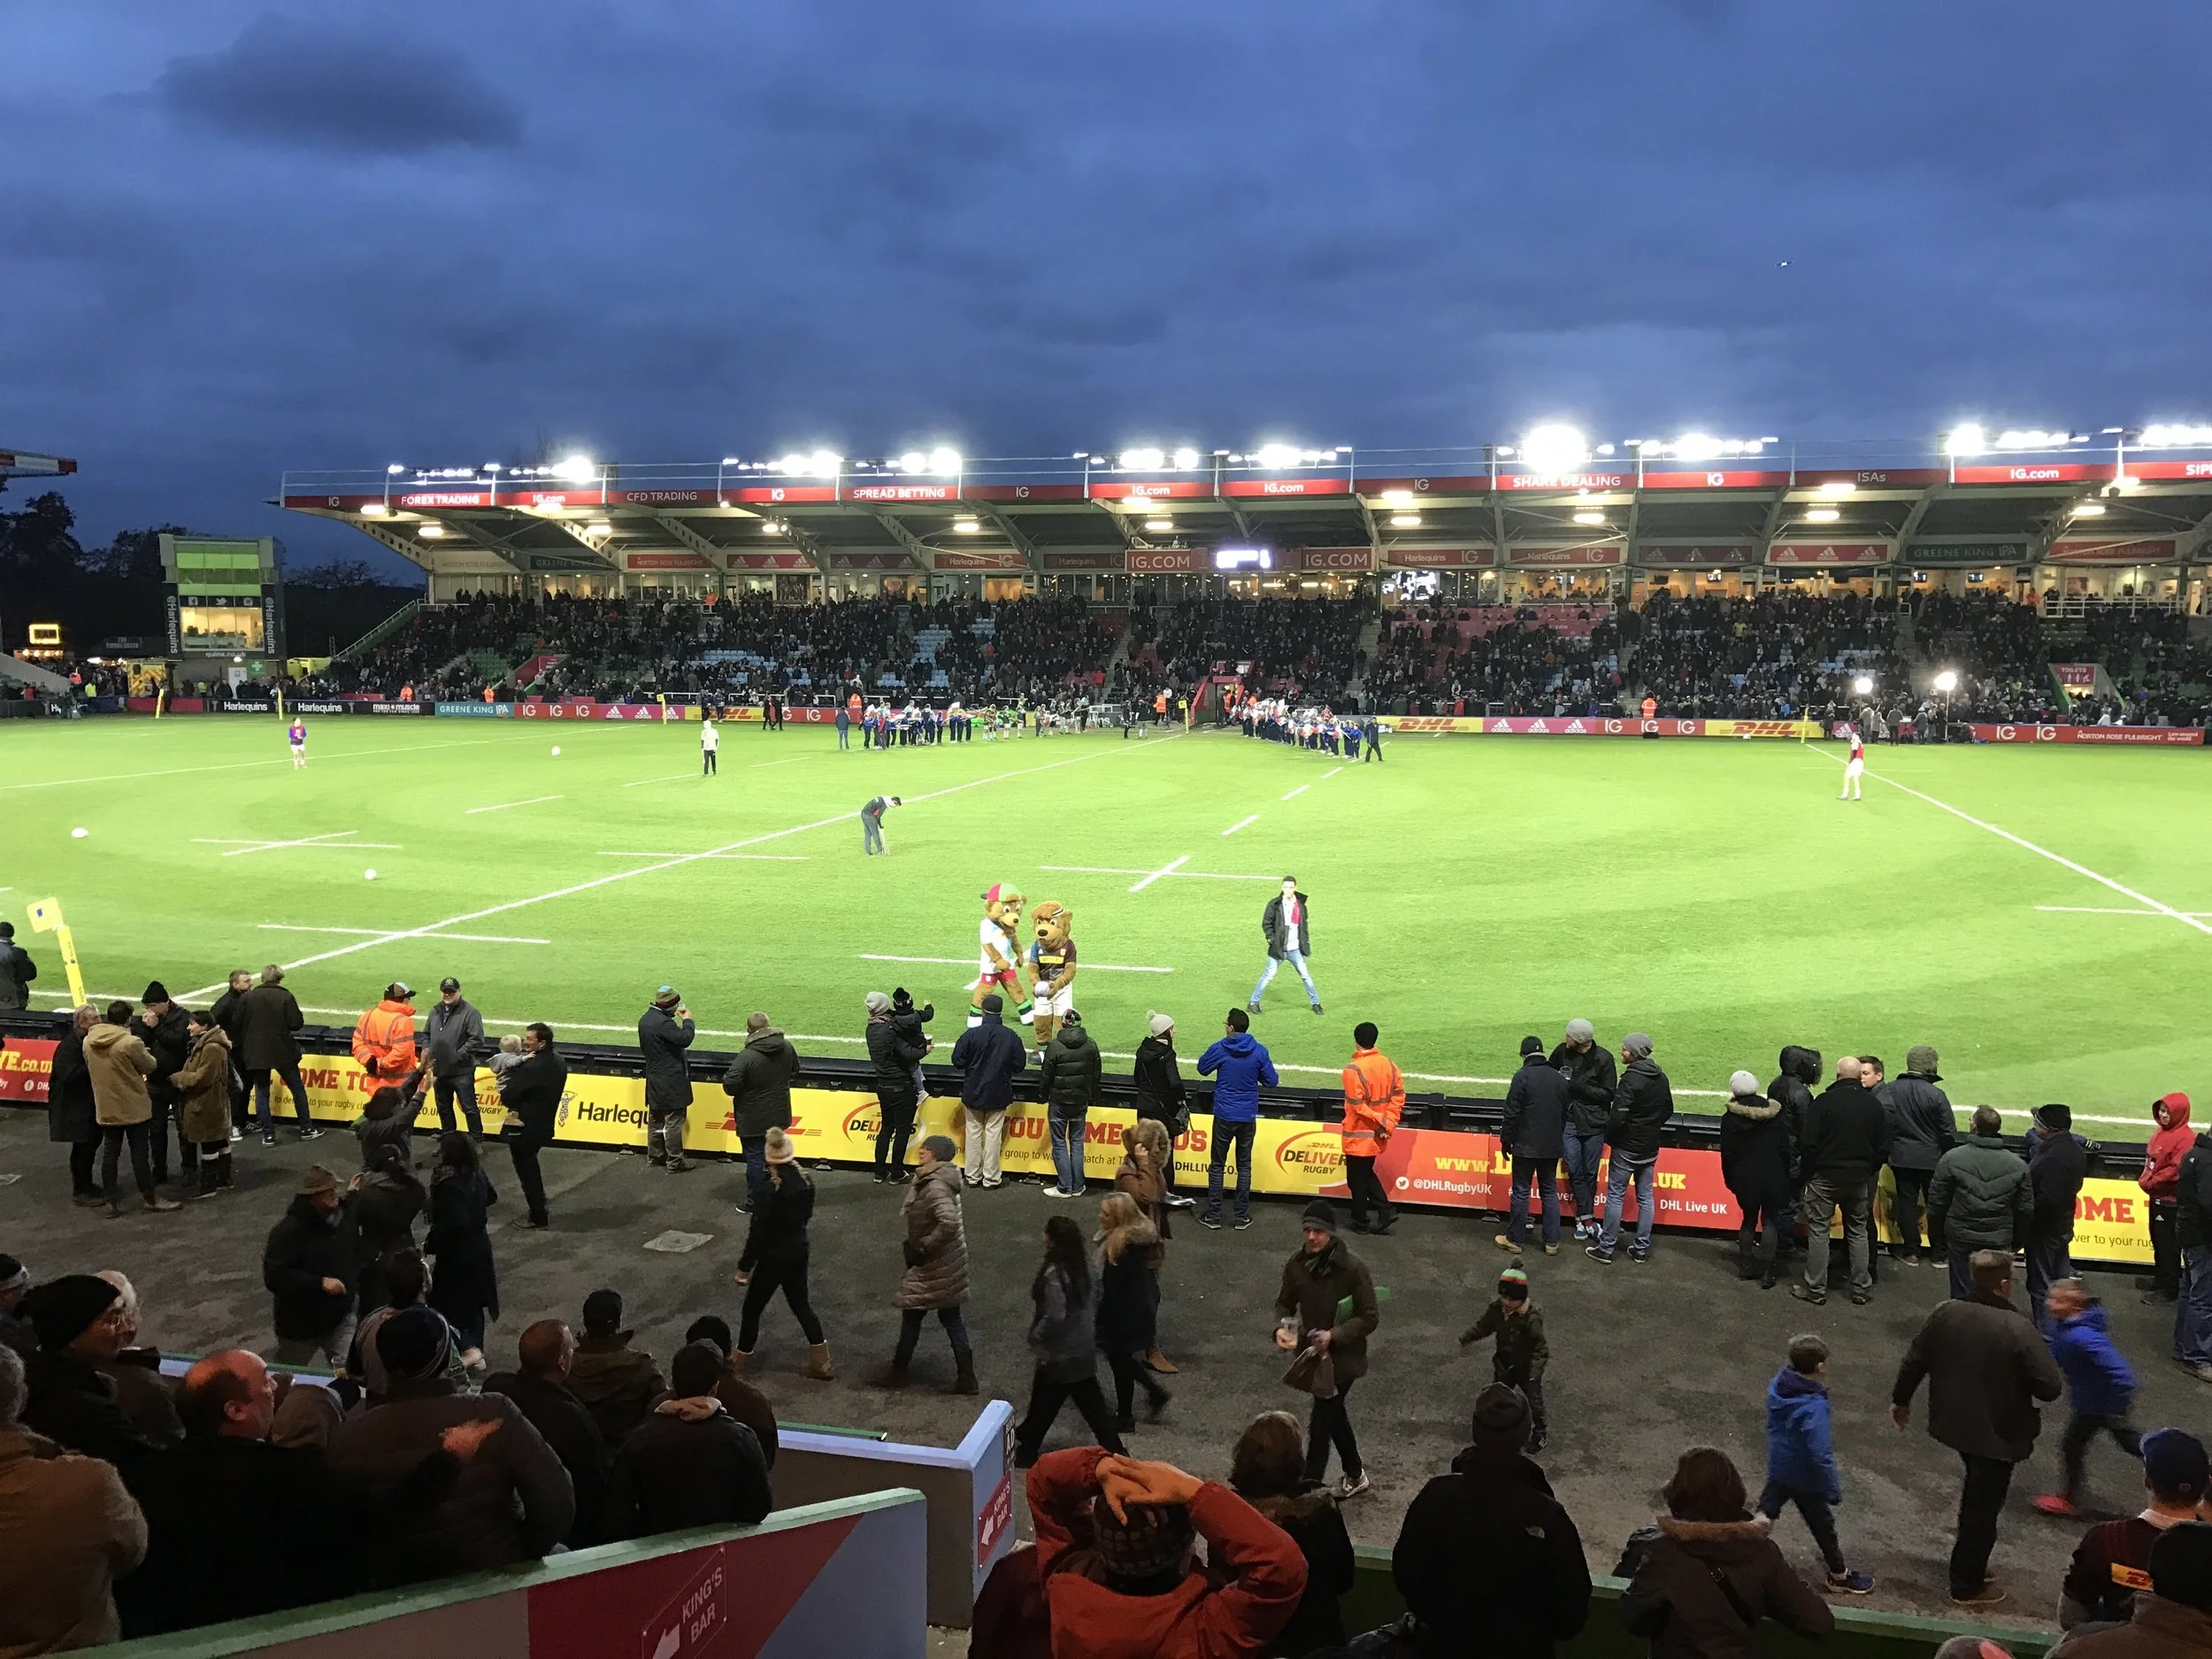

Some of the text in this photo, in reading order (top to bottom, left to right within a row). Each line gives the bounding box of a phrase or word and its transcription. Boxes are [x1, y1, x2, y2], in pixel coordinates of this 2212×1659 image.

[1707, 472, 1724, 487] IG
[1857, 472, 1886, 482] ISAs
[2010, 468, 2060, 480] IG.com
[1264, 482, 1304, 493] IG.com
[1414, 479, 1430, 490] IG
[1513, 476, 1621, 488] SHARE DEALING
[771, 488, 786, 501] IG
[853, 488, 946, 499] SPREAD BETTING
[1016, 487, 1030, 498] IG
[1132, 485, 1171, 495] IG.com
[328, 496, 341, 507] IG
[401, 493, 480, 505] FOREX TRADING
[533, 493, 566, 503] IG.com
[626, 491, 697, 502] CFD TRADING
[1461, 549, 1479, 564] IG
[1527, 548, 1604, 563] Harlequins IG
[1914, 548, 1960, 557] GREENE
[1998, 544, 2017, 557] IPA
[999, 555, 1014, 567] IG
[1058, 555, 1125, 567] Harlequins IG
[1131, 556, 1190, 568] IG.COM
[1305, 553, 1368, 567] IG.COM
[166, 595, 179, 654] @Harlequins
[265, 597, 276, 655] @Harlequins
[224, 702, 268, 712] Harlequins
[297, 703, 342, 714] Harlequins
[495, 704, 509, 715] IPA
[523, 704, 536, 717] IG
[549, 704, 563, 717] IG
[576, 705, 589, 717] IG
[806, 709, 821, 721] IG
[1398, 718, 1457, 730] DHL
[1604, 719, 1623, 733] IG
[1640, 719, 1659, 733] IG
[1677, 720, 1695, 734] IG
[1732, 721, 1797, 735] DHL
[1996, 726, 2016, 741] IG
[2036, 726, 2057, 741] IG
[37, 1081, 50, 1091] DH
[274, 1094, 281, 1103] to
[310, 1095, 316, 1105] to
[318, 1097, 334, 1109] your
[335, 1100, 355, 1110] rugby
[1004, 1148, 1030, 1161] group
[1032, 1150, 1041, 1160] to
[1107, 1156, 1116, 1165] at
[1283, 1149, 1347, 1166] DELIVER
[1302, 1165, 1336, 1174] RUGBY
[1413, 1179, 1493, 1195] @DHLRugbyUK
[1660, 1199, 1727, 1215] DHL Live UK
[2093, 1234, 2106, 1245] to
[2108, 1236, 2134, 1248] your
[2137, 1238, 2155, 1250] rug
[682, 1567, 722, 1624] KING'S
[690, 1602, 716, 1645] BAR
